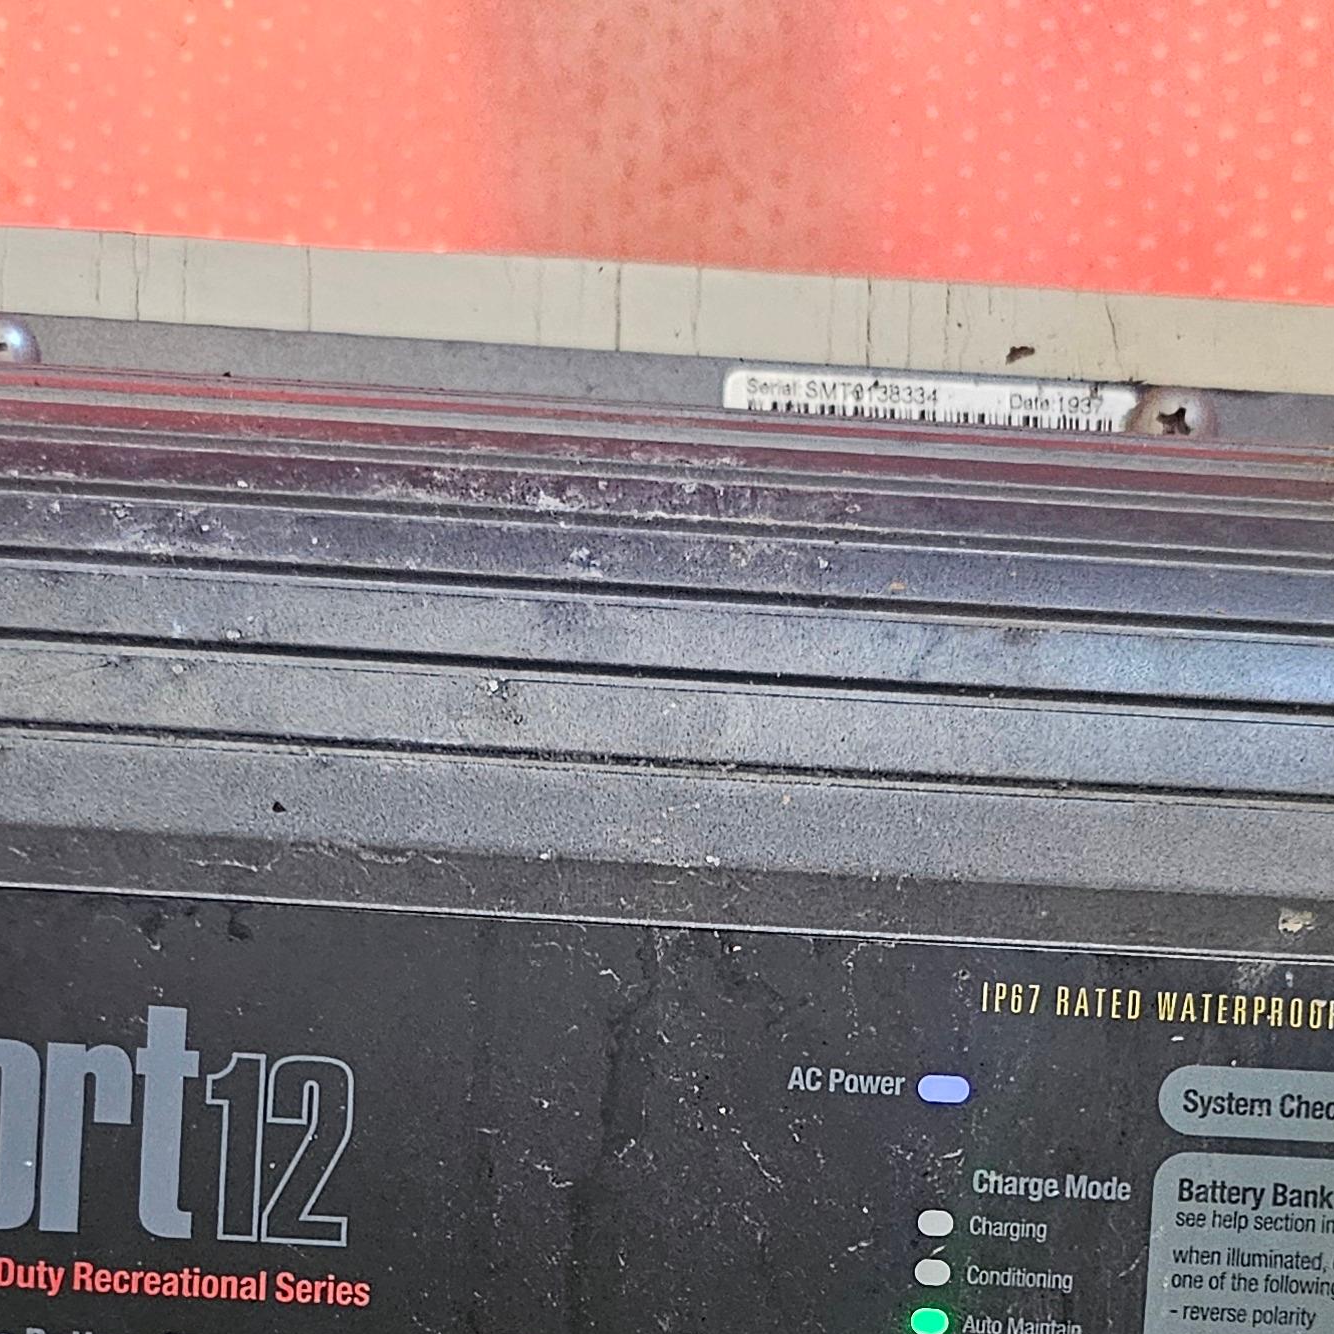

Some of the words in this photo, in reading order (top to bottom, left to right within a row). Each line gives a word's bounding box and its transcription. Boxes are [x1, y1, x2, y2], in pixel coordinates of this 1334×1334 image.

[981, 982, 1039, 1014] IP67
[1056, 988, 1141, 1020] RATED
[788, 1066, 823, 1093] AC
[828, 1069, 905, 1097] Power
[1183, 1088, 1271, 1118] System
[973, 1169, 1059, 1201] Charge
[1065, 1174, 1131, 1200] Mode
[1178, 1178, 1265, 1211] Battery
[1272, 1183, 1333, 1210] Bank
[969, 1215, 1047, 1243] Charging
[1175, 1211, 1206, 1228] see
[1212, 1210, 1248, 1234] help
[1253, 1214, 1316, 1233] section
[1173, 1247, 1222, 1266] when
[1226, 1248, 1328, 1274] illuminated,
[73, 1261, 267, 1301] Recreational
[275, 1271, 371, 1307] Series
[967, 1265, 1073, 1293] Conditioning
[1172, 1273, 1203, 1290] one
[1208, 1271, 1228, 1291] of
[1231, 1272, 1258, 1293] the
[1182, 1304, 1246, 1325] reverse
[1253, 1307, 1316, 1329] polarity
